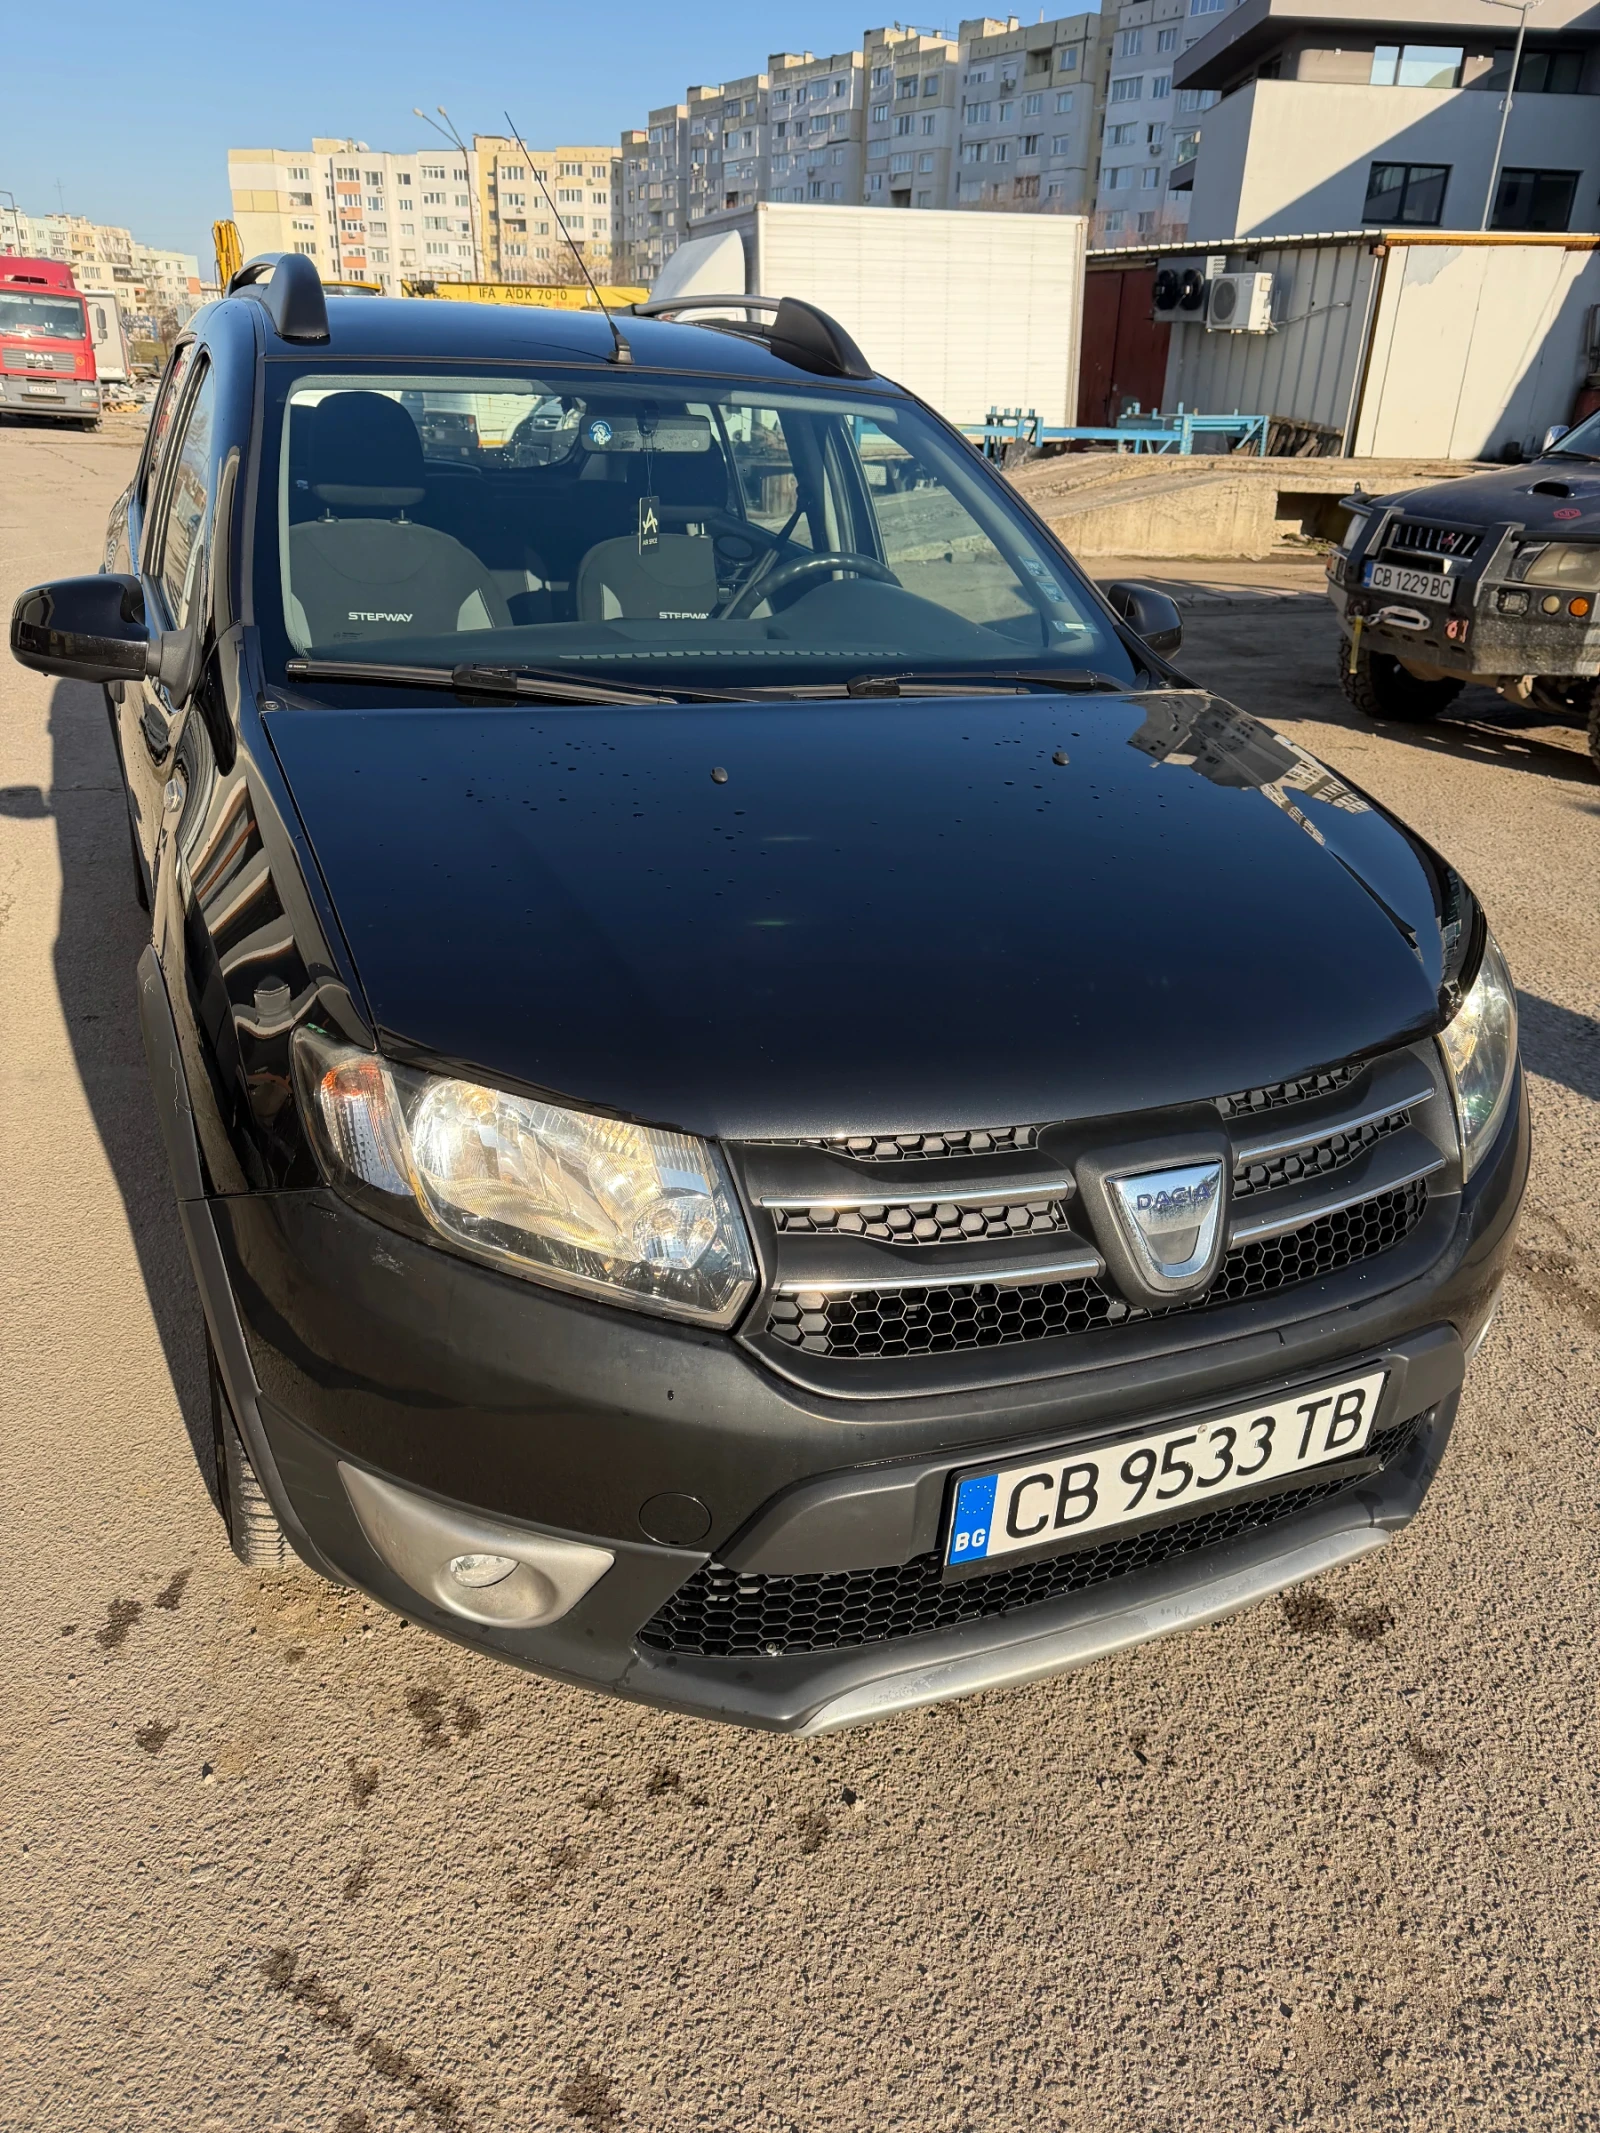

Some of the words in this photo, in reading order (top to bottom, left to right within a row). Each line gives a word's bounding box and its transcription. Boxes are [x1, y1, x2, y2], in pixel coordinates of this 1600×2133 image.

[479, 287, 496, 299] IFA
[505, 288, 533, 300] ADK
[25, 352, 54, 362] MAN
[1373, 567, 1393, 588] CB
[1395, 570, 1430, 596] 1229
[1429, 577, 1452, 600] BC
[347, 611, 414, 623] STEPWAY
[658, 611, 710, 620] STEPWA
[1136, 1182, 1213, 1211] DACIA
[1005, 1462, 1100, 1540] CB
[1119, 1415, 1277, 1512] 9533
[1296, 1387, 1367, 1460] TB
[953, 1527, 987, 1553] BG
